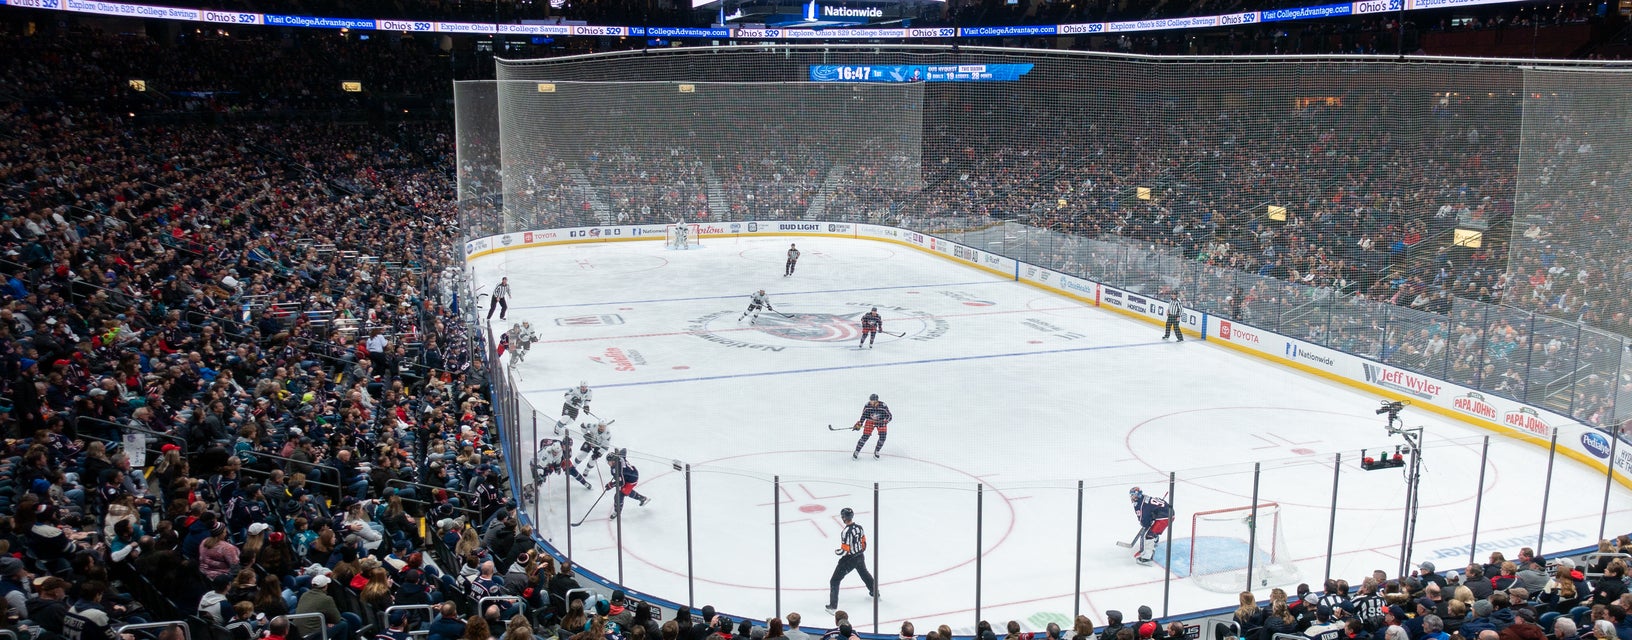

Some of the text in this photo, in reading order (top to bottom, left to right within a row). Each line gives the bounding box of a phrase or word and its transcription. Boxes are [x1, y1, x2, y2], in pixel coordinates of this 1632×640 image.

[42, 0, 59, 8] 529
[68, 0, 198, 19] Explore Ohio's 529 College Savings
[1359, 1, 1387, 13] Ohio's
[206, 12, 256, 23] Ohio's 529
[824, 5, 883, 18] Nationwide
[1262, 6, 1350, 20] Visit CollegeAdvantage.com
[267, 15, 374, 28] Visit CollegeAdvantage.com
[1110, 15, 1216, 31] Explore Ohio's 529 College Savings
[1221, 13, 1256, 25] Ohio's 529
[384, 21, 431, 31] Ohio's 529
[440, 23, 470, 33] Explore
[471, 24, 494, 32] Ohio's
[509, 25, 539, 34] College
[540, 25, 568, 34] Savings
[576, 26, 622, 36] Ohio's 529
[963, 25, 1055, 36] Visit CollegeAdvantage.com
[1063, 23, 1103, 33] Ohio's 529
[632, 27, 728, 38] Visi CollegeAdvantage.com
[737, 28, 780, 38] Ohio's 529
[788, 30, 814, 38] Explore
[850, 30, 877, 38] College
[878, 30, 904, 38] Savings
[912, 28, 954, 38] Ohio's 529
[836, 66, 871, 80] 16:47
[779, 223, 820, 231] BUD LIGHT
[534, 232, 557, 240] TOYOTA
[1233, 328, 1260, 345] TOYOTA
[1298, 348, 1334, 367] Nationwide
[1382, 368, 1404, 385] Jeff
[1405, 374, 1442, 396] Wyler
[1454, 398, 1496, 419] PAPA JOHN'S
[1505, 413, 1524, 428] PAPA
[1583, 434, 1611, 456] Pedialyte
